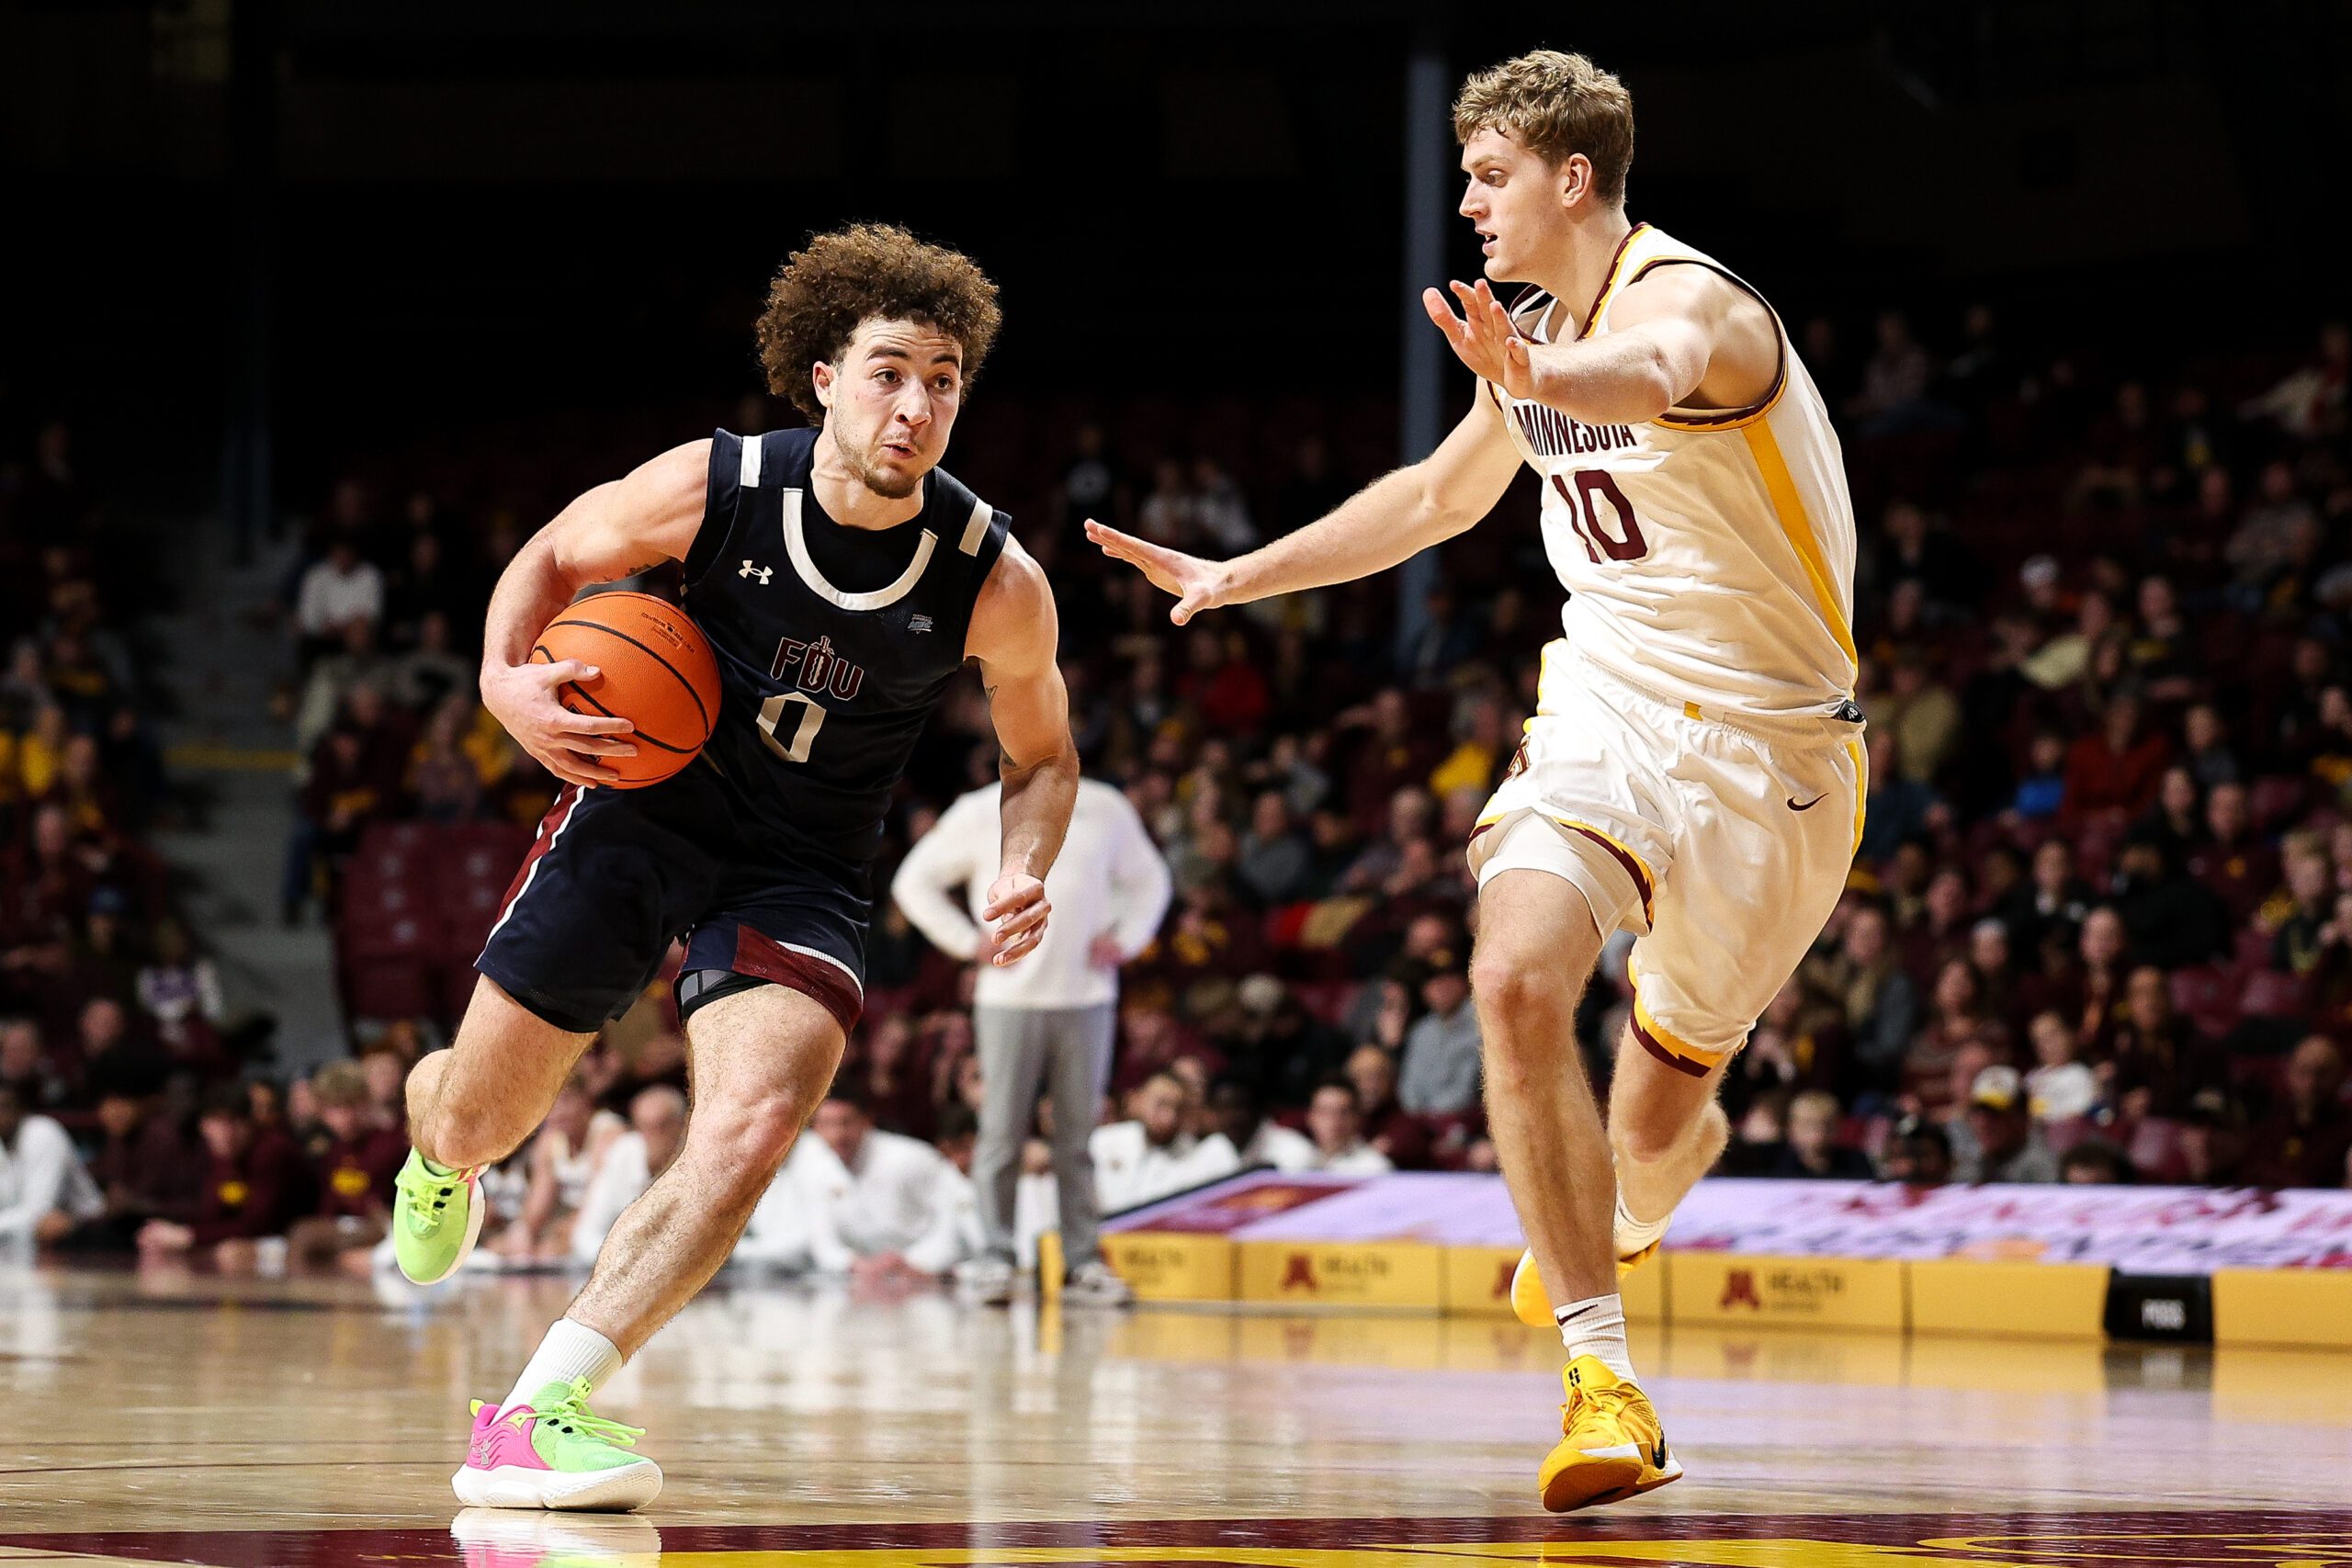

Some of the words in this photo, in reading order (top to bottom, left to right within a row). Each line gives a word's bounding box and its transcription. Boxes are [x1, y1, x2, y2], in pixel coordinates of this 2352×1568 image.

[1551, 469, 1648, 565] 10
[770, 636, 865, 701] FDU
[756, 692, 827, 762] 0
